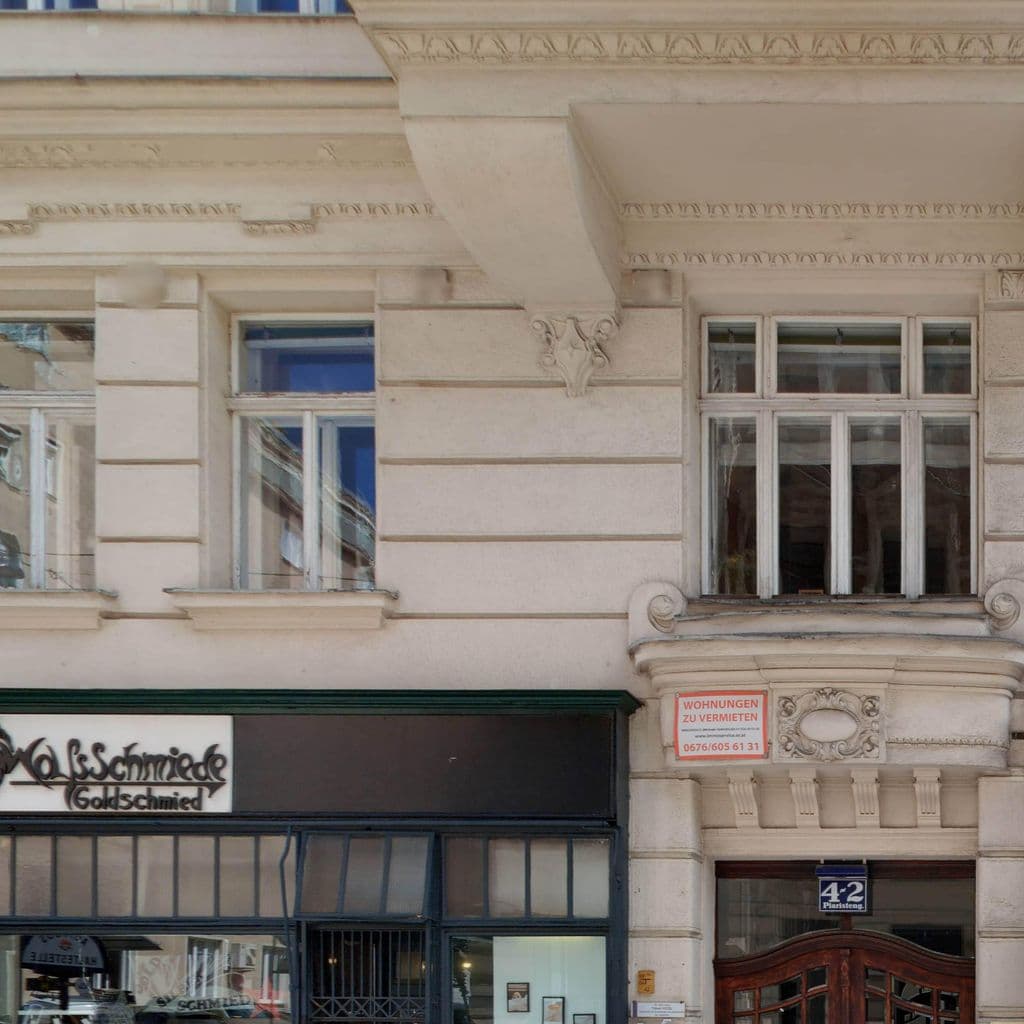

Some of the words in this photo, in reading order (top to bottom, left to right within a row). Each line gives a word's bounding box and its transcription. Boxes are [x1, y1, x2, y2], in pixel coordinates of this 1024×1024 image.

[683, 699, 759, 710] WOHNUNGEN
[682, 714, 697, 723] ZU
[699, 712, 758, 722] VERMIETEN
[683, 742, 730, 752] 0676/605
[732, 742, 744, 751] 61
[747, 742, 759, 751] 31
[72, 786, 203, 810] Goldschmied
